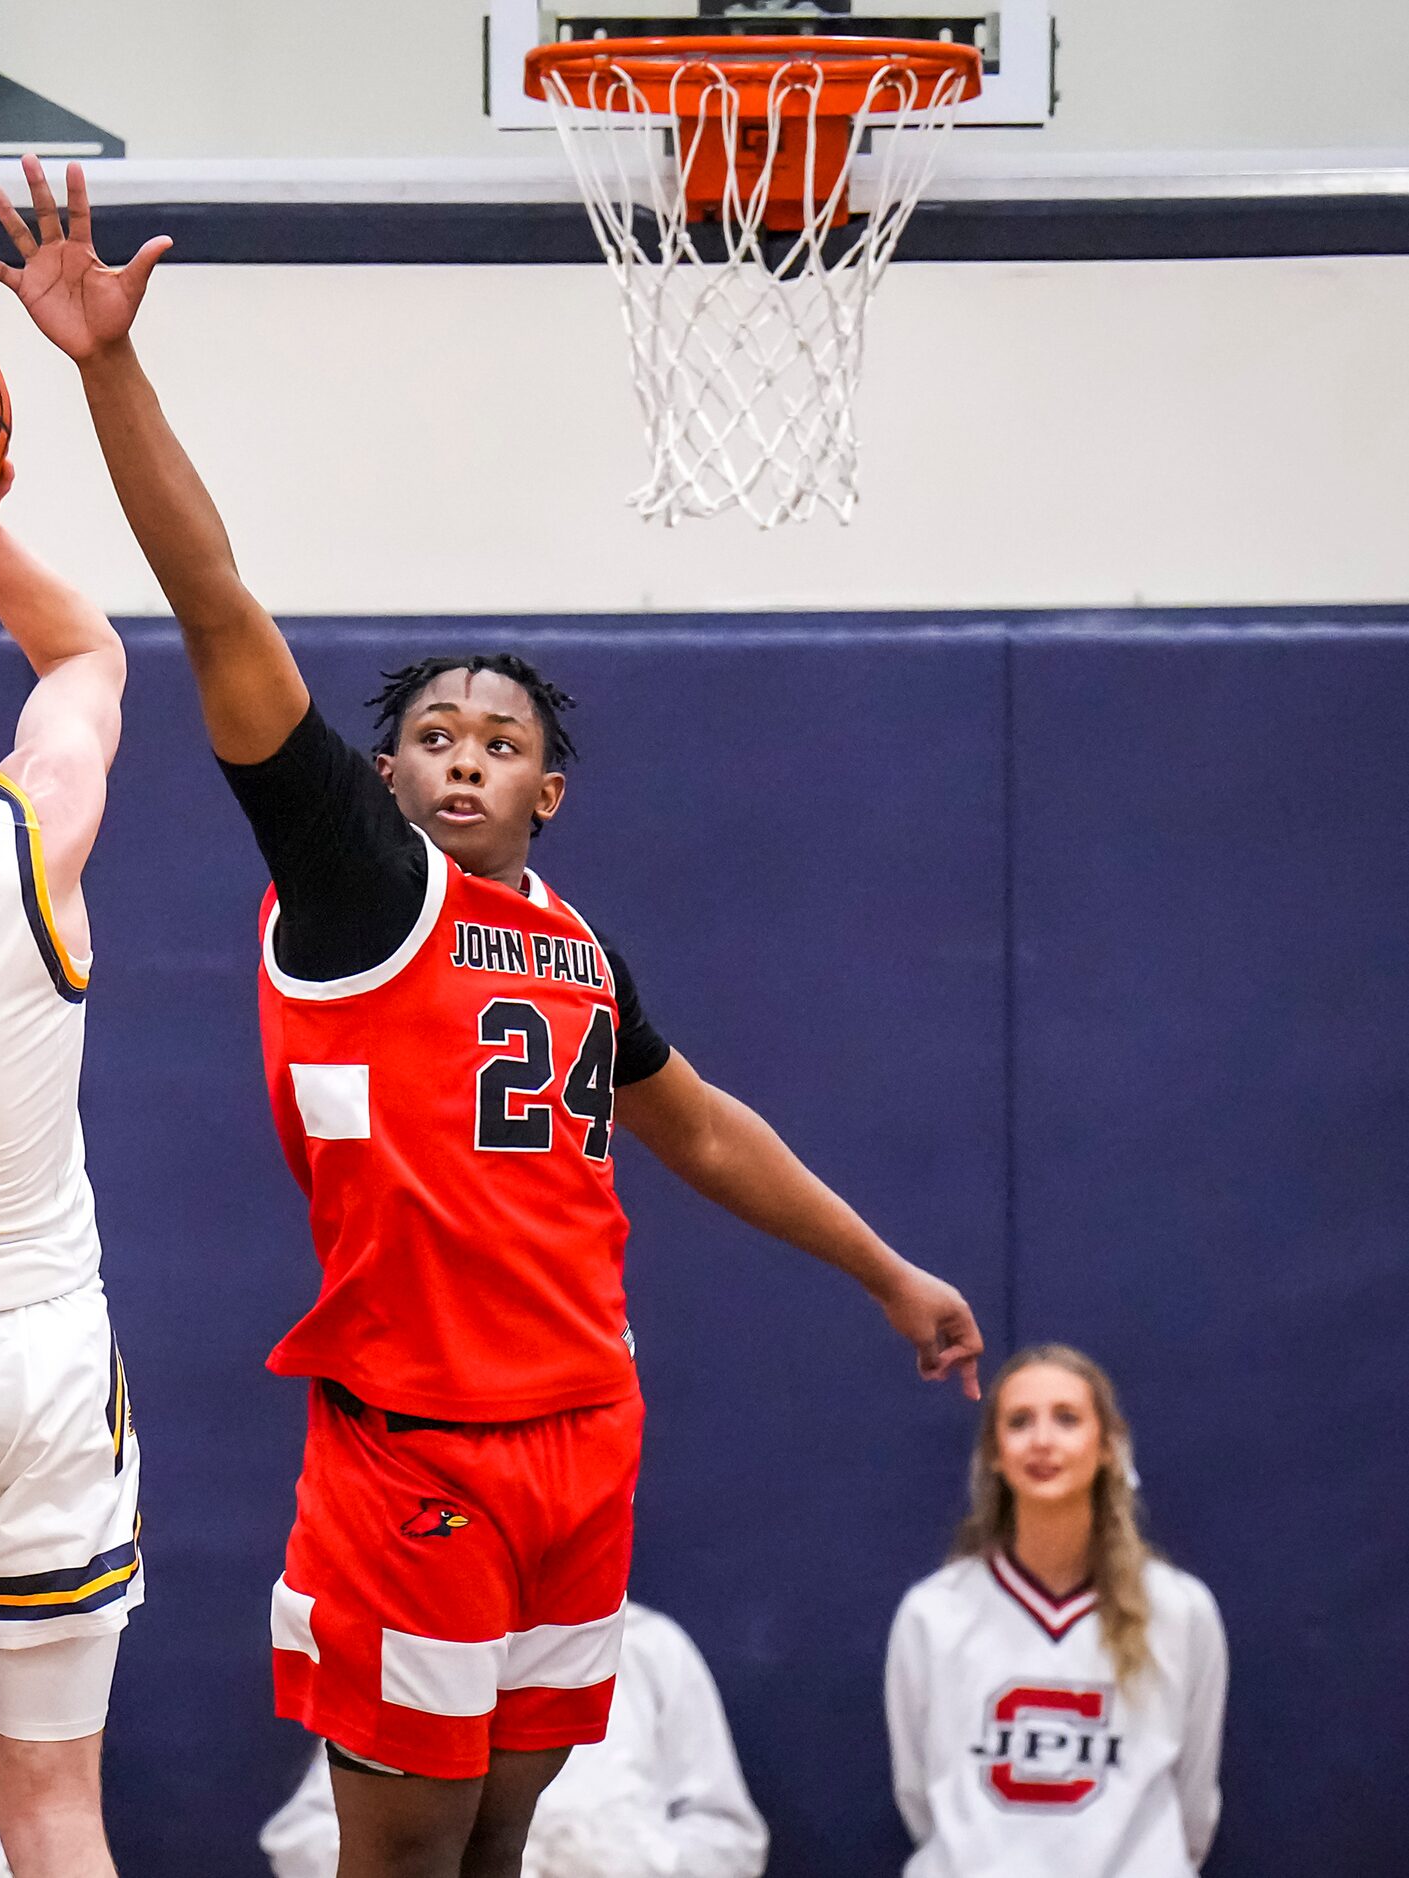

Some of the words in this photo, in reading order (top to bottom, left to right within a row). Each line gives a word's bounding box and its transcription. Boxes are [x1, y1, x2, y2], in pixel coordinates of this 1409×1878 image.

[450, 920, 528, 975] JOHN
[529, 933, 605, 989] PAUL
[474, 997, 616, 1163] 24
[969, 1730, 1123, 1766] JPII
